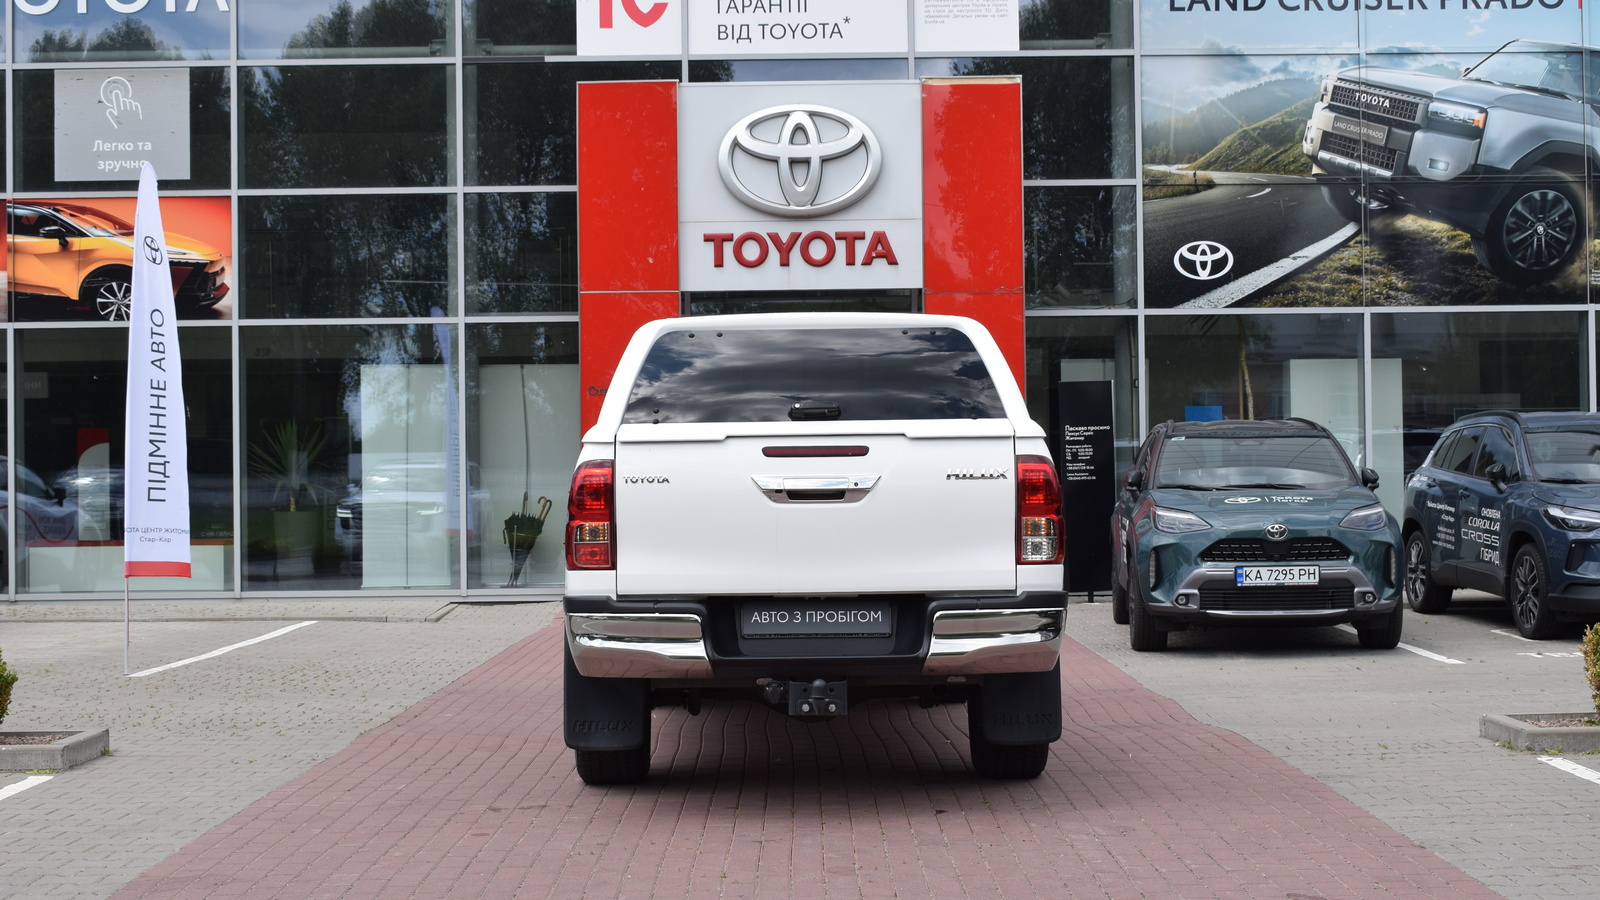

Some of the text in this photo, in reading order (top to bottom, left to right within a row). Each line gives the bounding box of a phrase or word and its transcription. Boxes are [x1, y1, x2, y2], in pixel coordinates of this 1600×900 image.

[717, 24, 752, 44] ВІД
[1355, 92, 1390, 108] TOYOTA
[1334, 120, 1346, 130] LAND
[1367, 128, 1384, 139] PRADO
[92, 140, 152, 152] Легко та
[703, 231, 899, 268] TOYOTA
[147, 308, 170, 503] ПІДМІННЕ АВТО
[622, 475, 670, 484] TOYOTA
[946, 468, 1009, 480] HILUX
[1468, 516, 1500, 532] COROLLA
[1461, 528, 1500, 546] CROSS
[1244, 568, 1316, 582] KA 7295 PH
[751, 611, 789, 623] АВТО
[806, 610, 882, 622] ПРОБІГОМ
